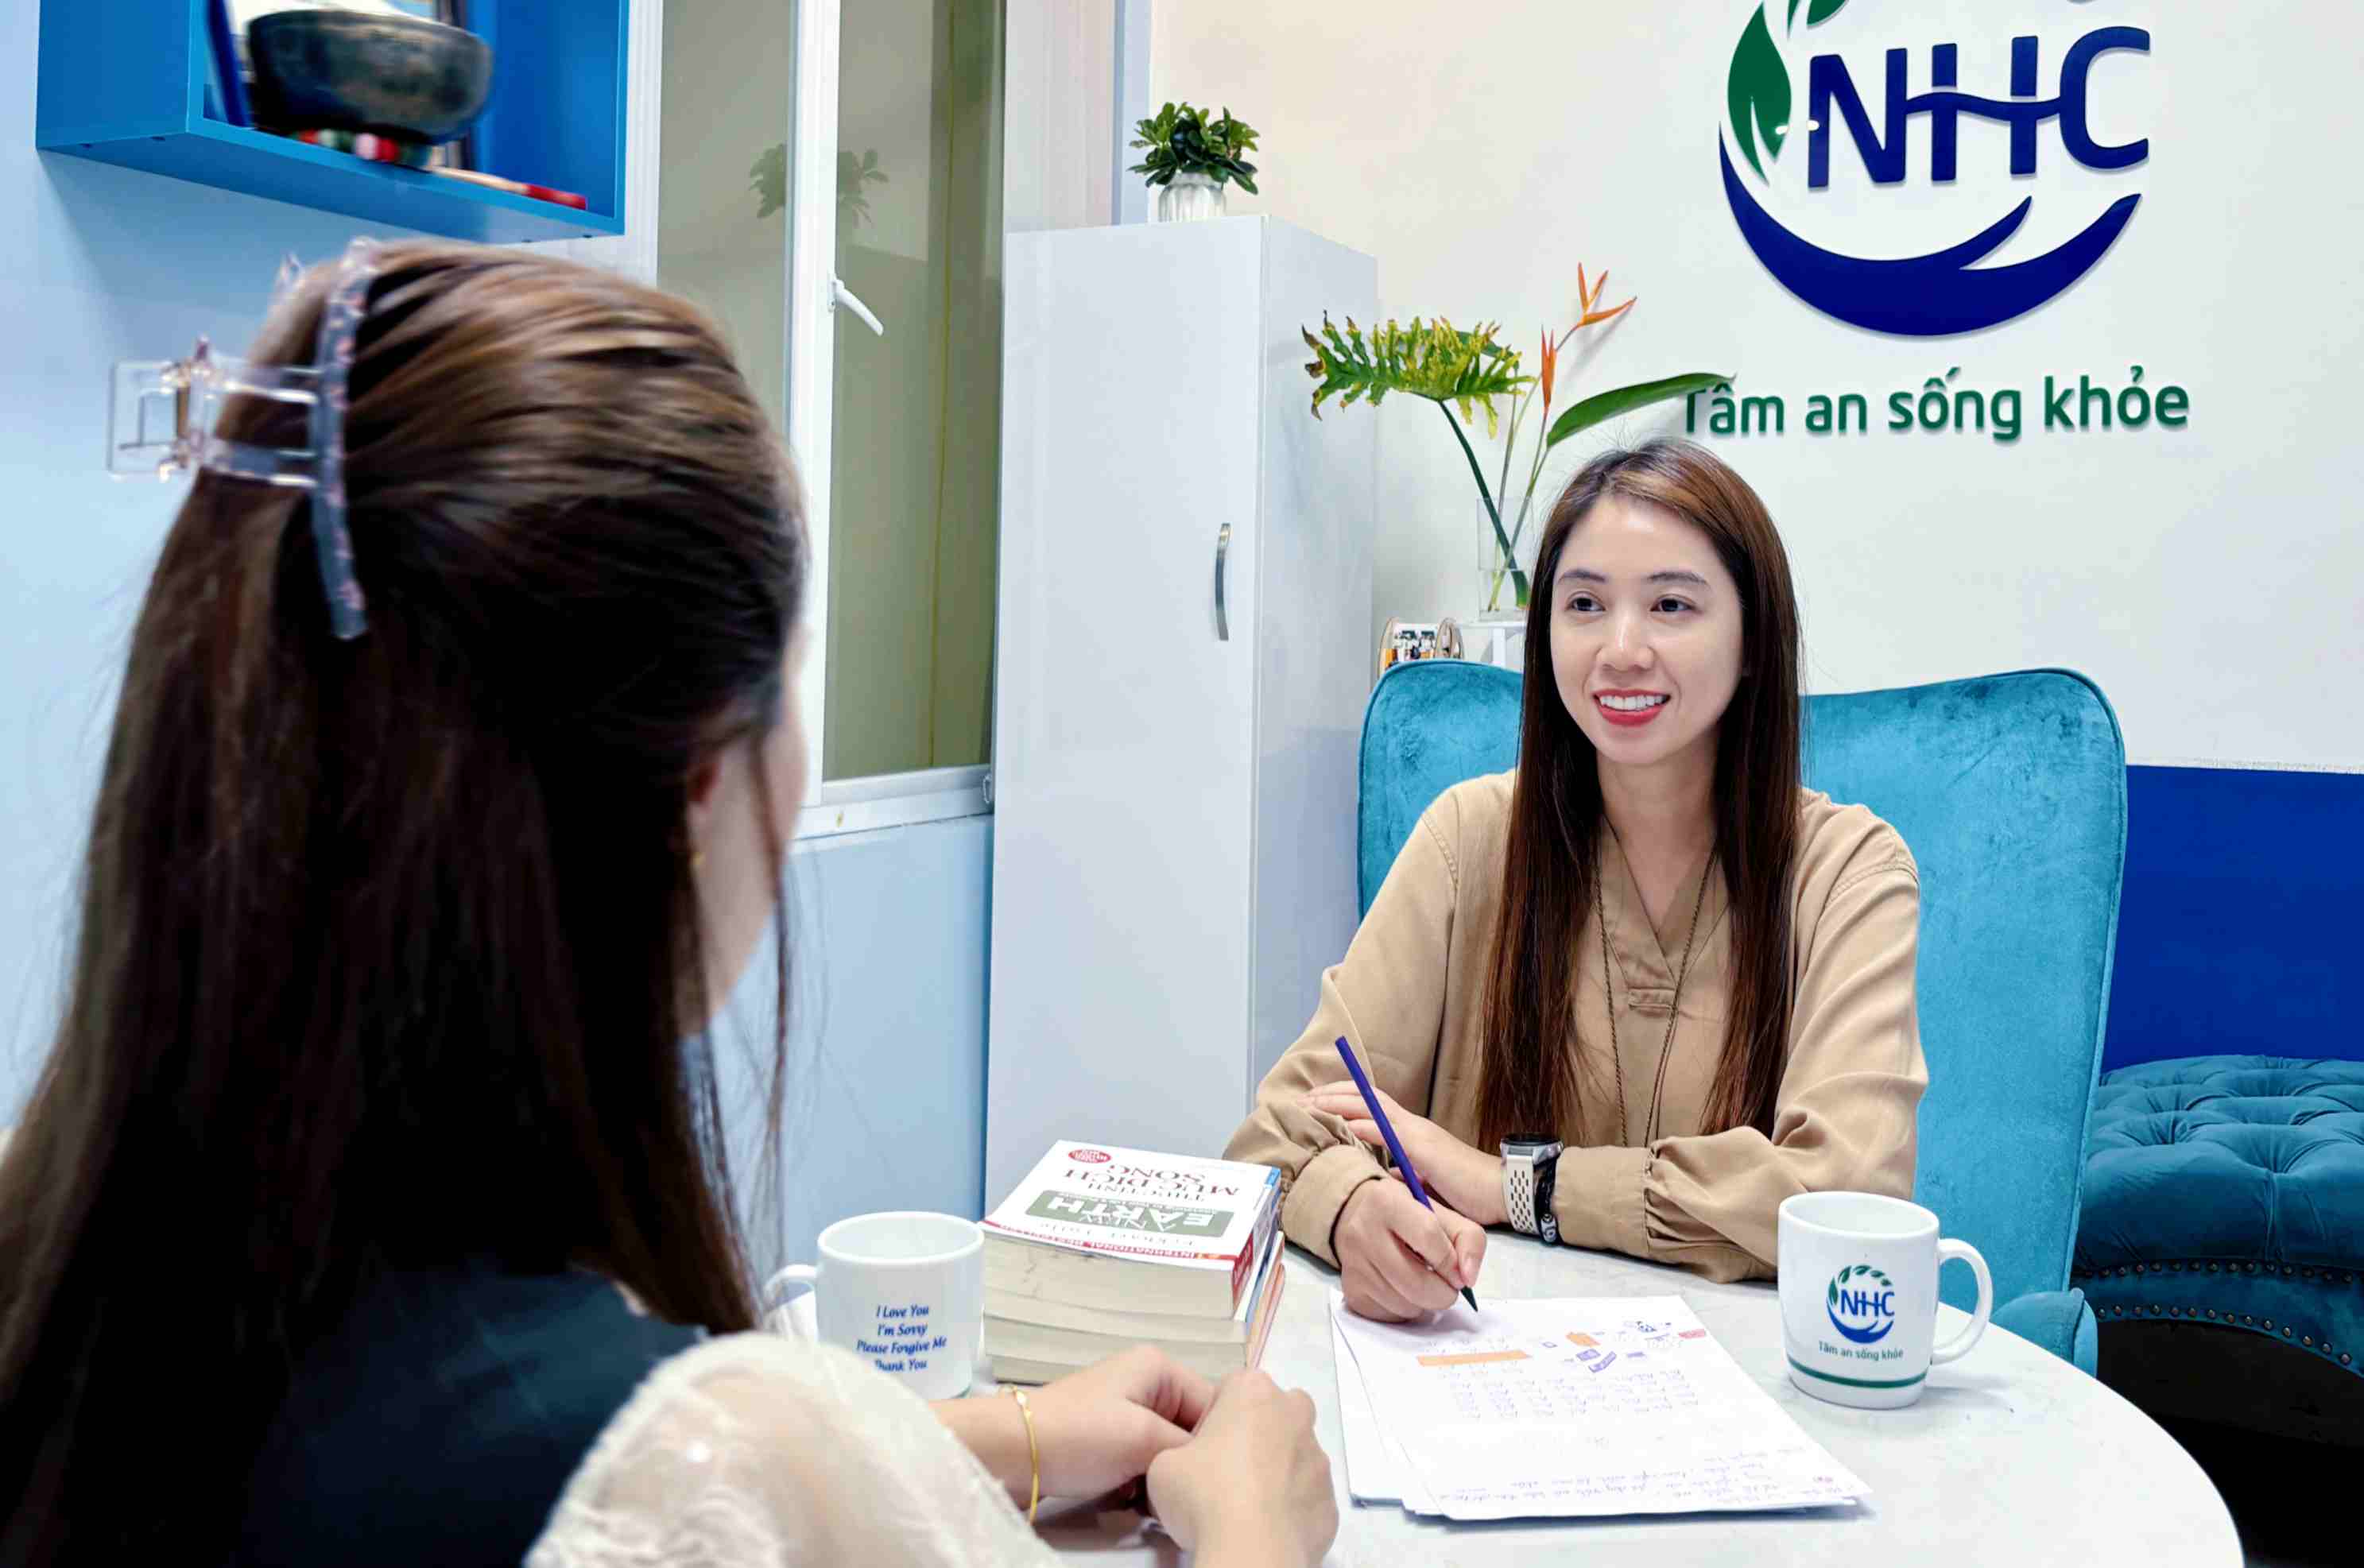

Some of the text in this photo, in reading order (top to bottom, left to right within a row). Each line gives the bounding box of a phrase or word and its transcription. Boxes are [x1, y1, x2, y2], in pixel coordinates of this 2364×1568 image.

[1808, 25, 2150, 189] NHC
[1686, 365, 2190, 442] Tâm an sống khỏe
[1048, 1195, 1215, 1227] EARTH
[877, 1304, 929, 1318] I Love You
[1841, 1289, 1895, 1317] NHC
[878, 1323, 928, 1337] I'm Sorry
[857, 1336, 948, 1356] Please Forgive Me
[1819, 1340, 1838, 1355] Tâm
[1841, 1349, 1854, 1357] an
[1855, 1347, 1879, 1361] sống
[909, 1358, 928, 1370] You
